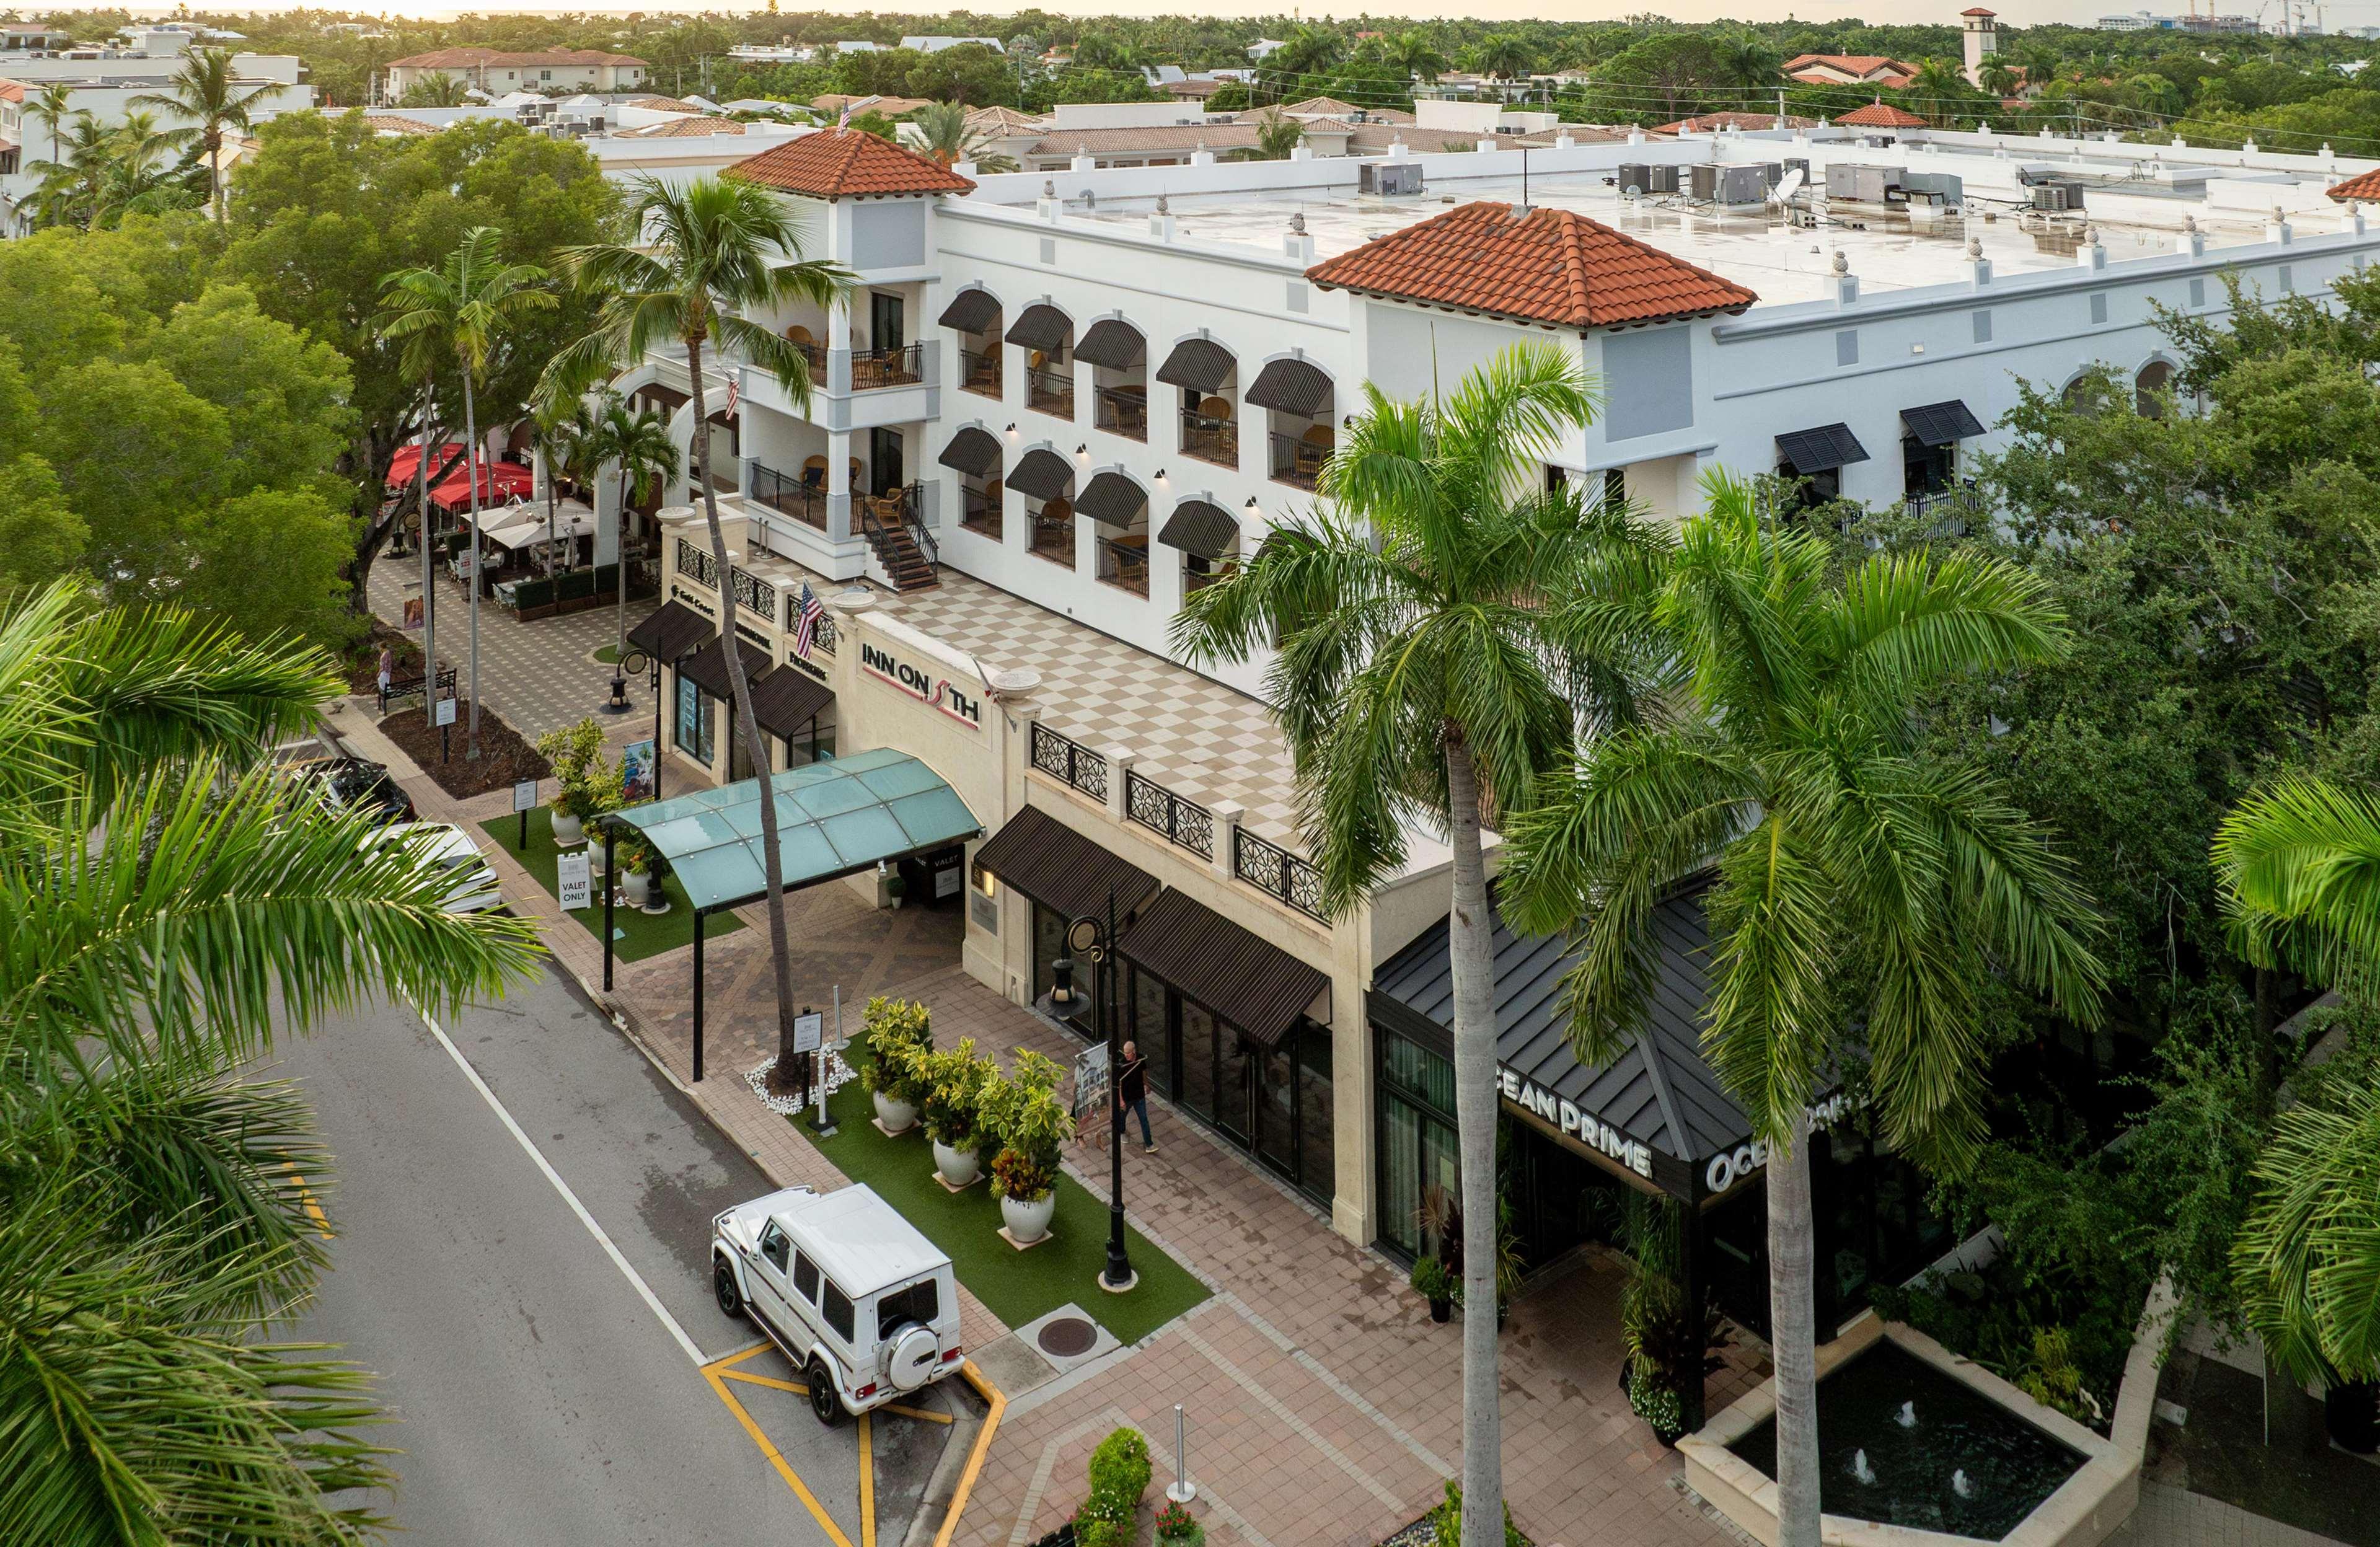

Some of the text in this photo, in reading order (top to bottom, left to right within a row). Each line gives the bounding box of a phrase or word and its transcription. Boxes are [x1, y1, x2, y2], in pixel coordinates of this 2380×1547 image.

[862, 643, 894, 676] INN
[899, 664, 928, 695] ON
[935, 854, 958, 866] VALET
[562, 881, 586, 891] VALET
[563, 892, 585, 902] ONLY
[1497, 1064, 1652, 1179] EAN PRIME
[1706, 1135, 1767, 1192] OCE
